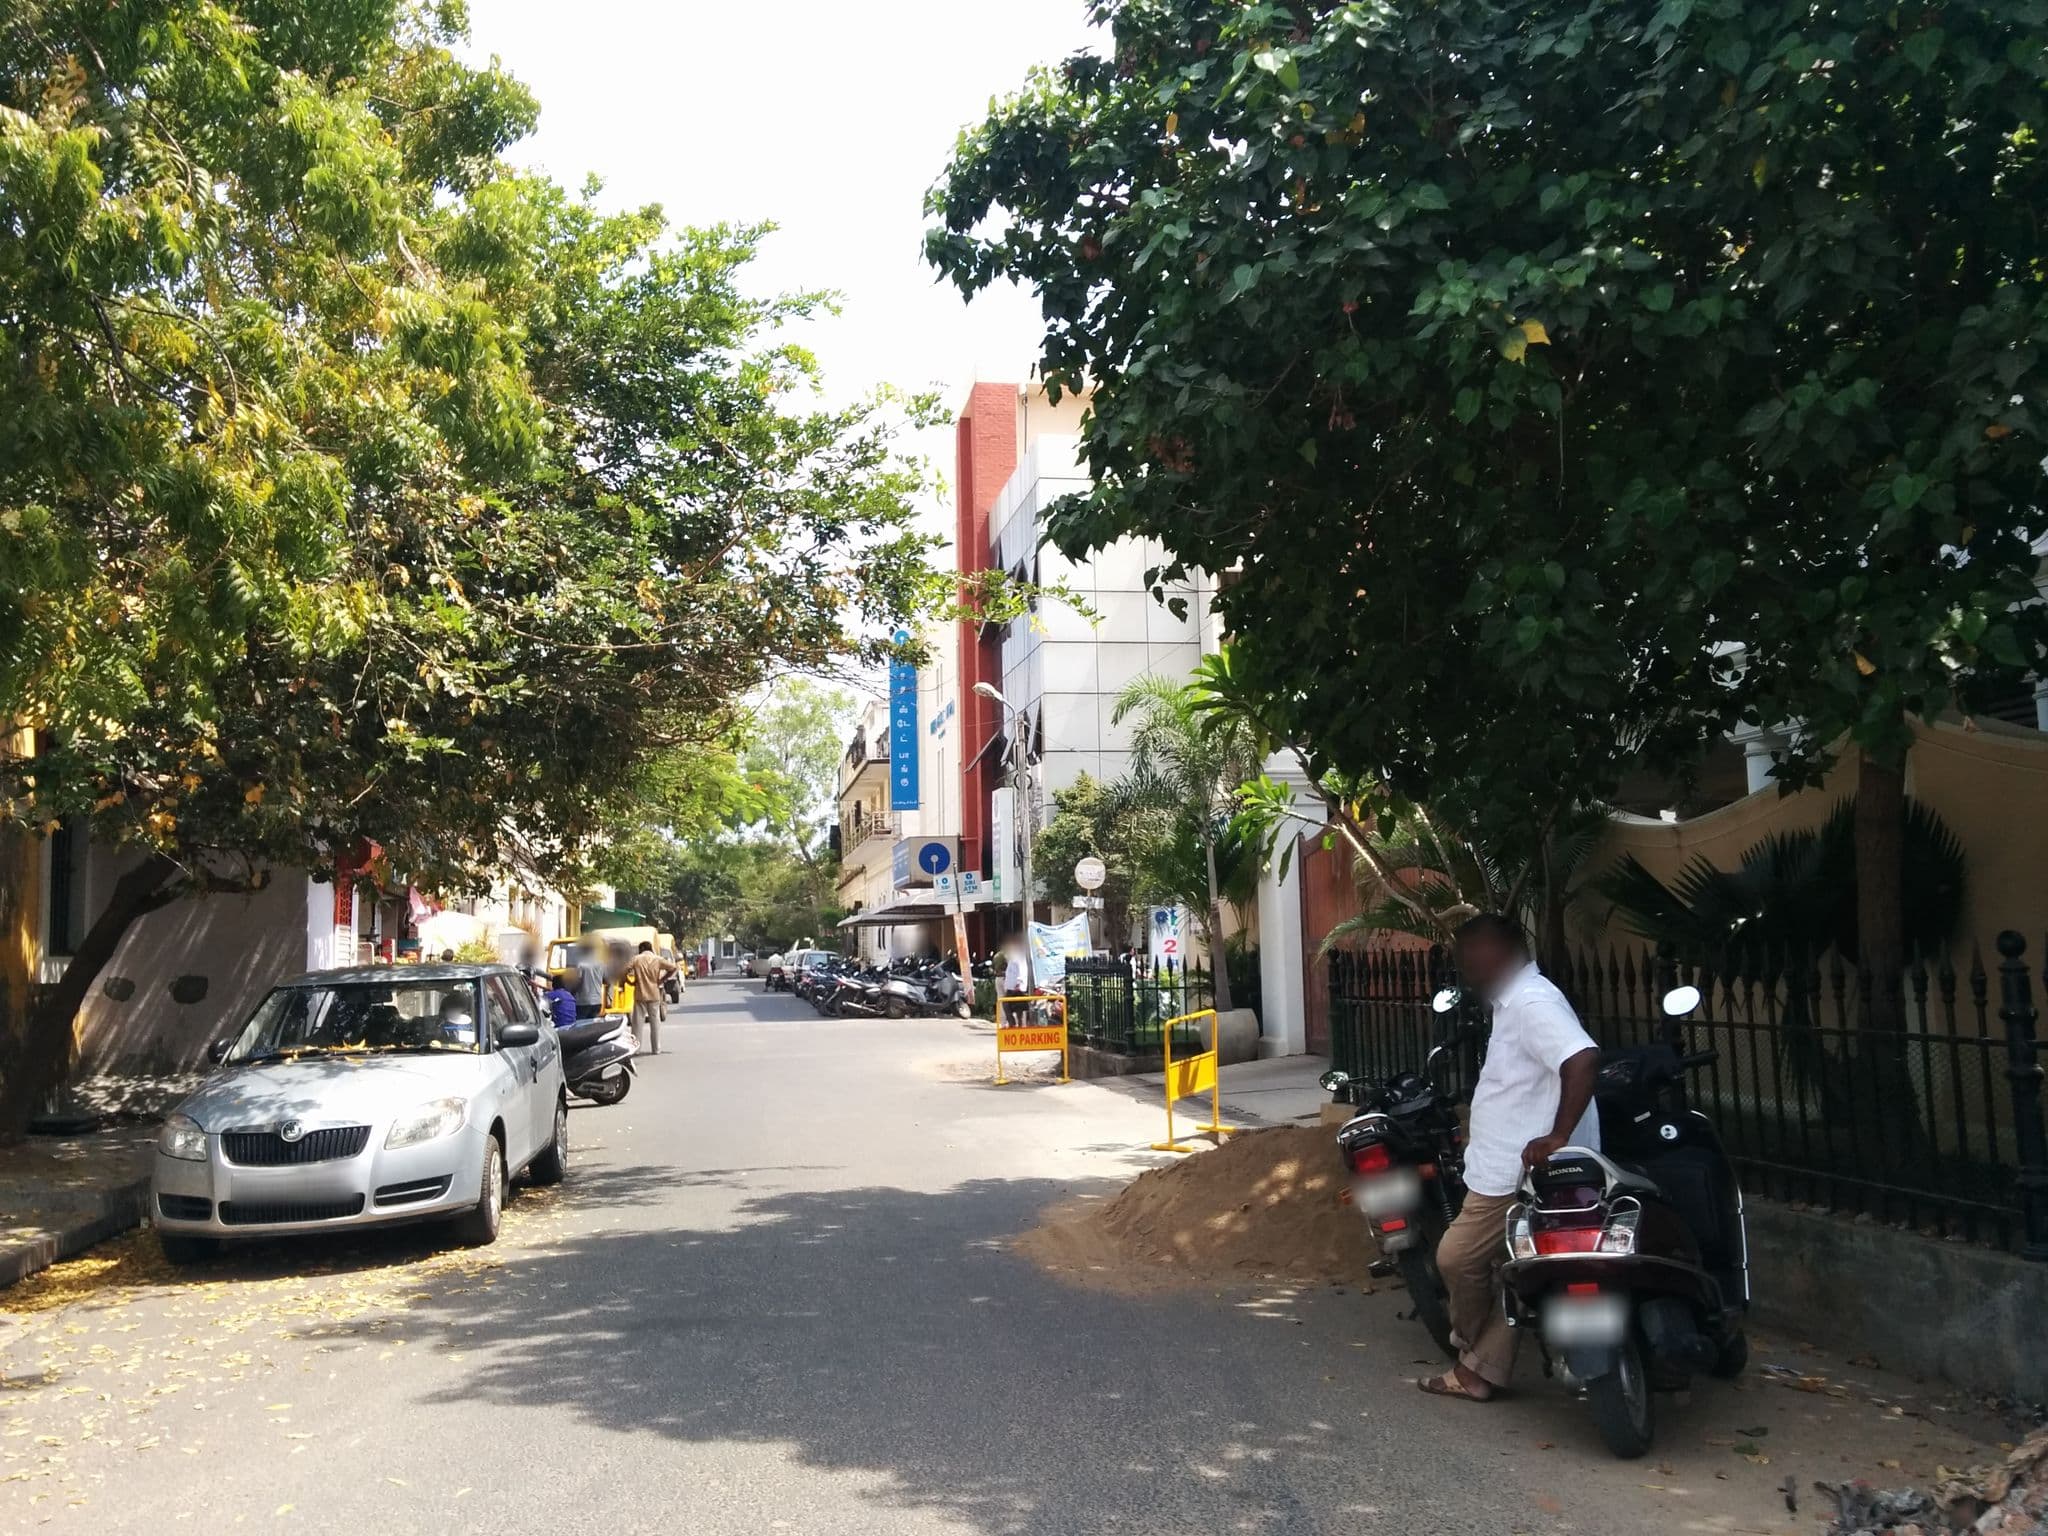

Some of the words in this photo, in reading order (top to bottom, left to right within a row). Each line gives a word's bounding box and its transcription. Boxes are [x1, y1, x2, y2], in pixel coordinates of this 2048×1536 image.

[1164, 939, 1177, 953] 2
[1004, 1034, 1017, 1045] NO
[1019, 1031, 1060, 1045] PARKING
[1548, 1166, 1583, 1176] HONDA
